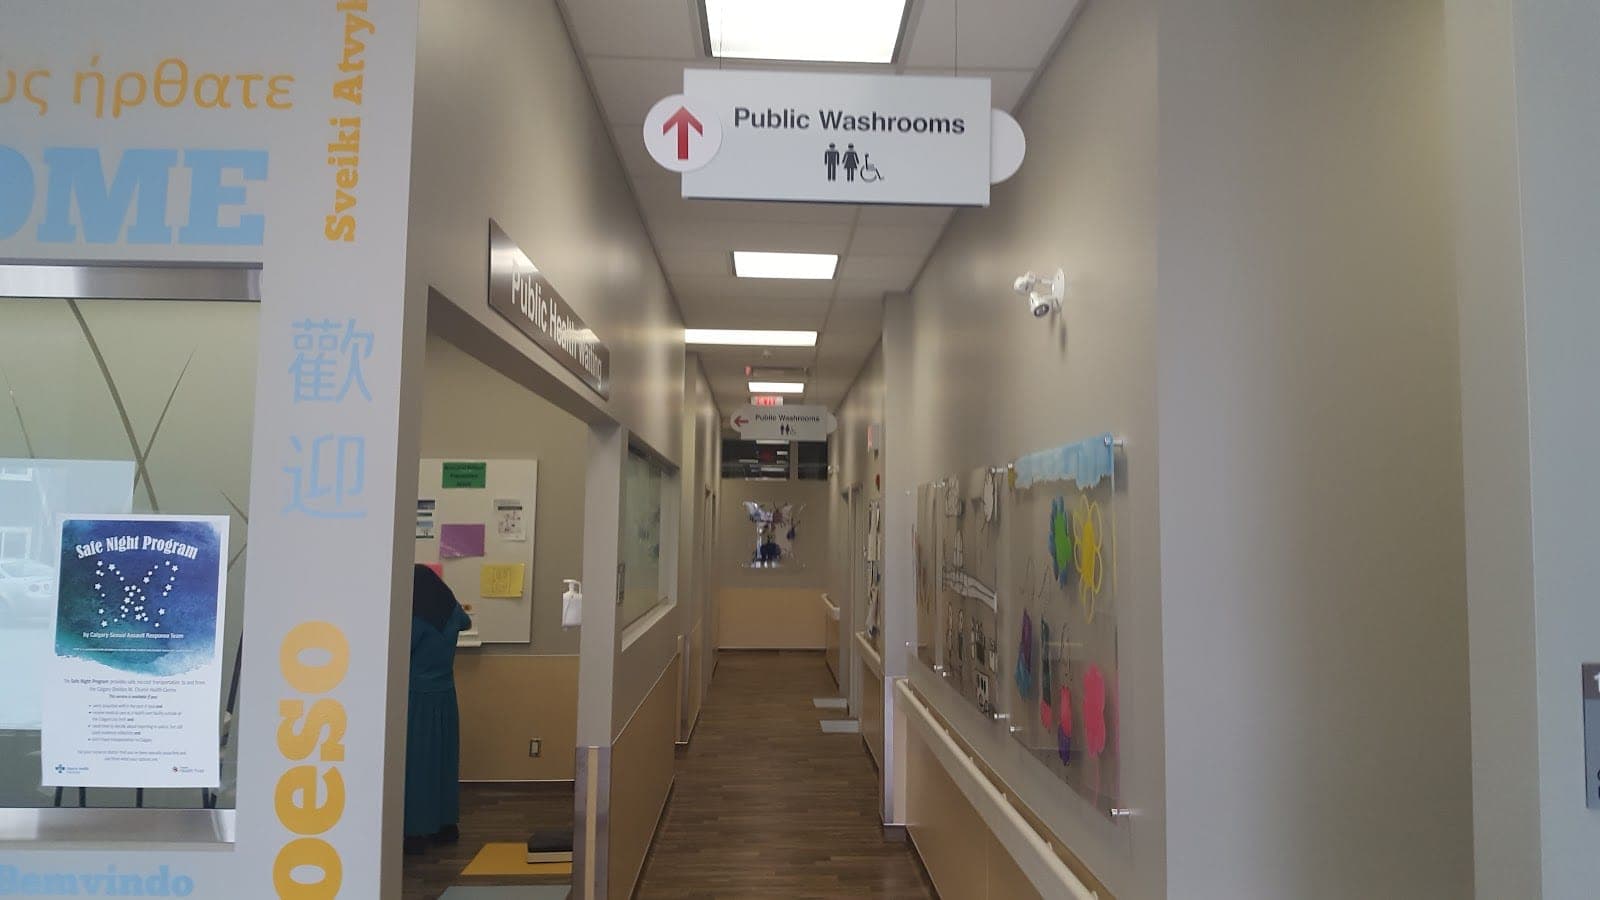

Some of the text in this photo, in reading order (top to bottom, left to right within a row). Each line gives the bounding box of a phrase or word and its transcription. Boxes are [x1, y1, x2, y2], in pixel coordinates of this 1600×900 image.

[73, 55, 295, 118] ήρθατε
[734, 106, 966, 135] Public Washrooms
[325, 117, 361, 242] Sveiki
[511, 262, 548, 333] Public
[549, 297, 577, 360] Health
[280, 318, 375, 520] 歡迎
[778, 414, 820, 422] Washrooms
[75, 535, 199, 560] Safe Night Program
